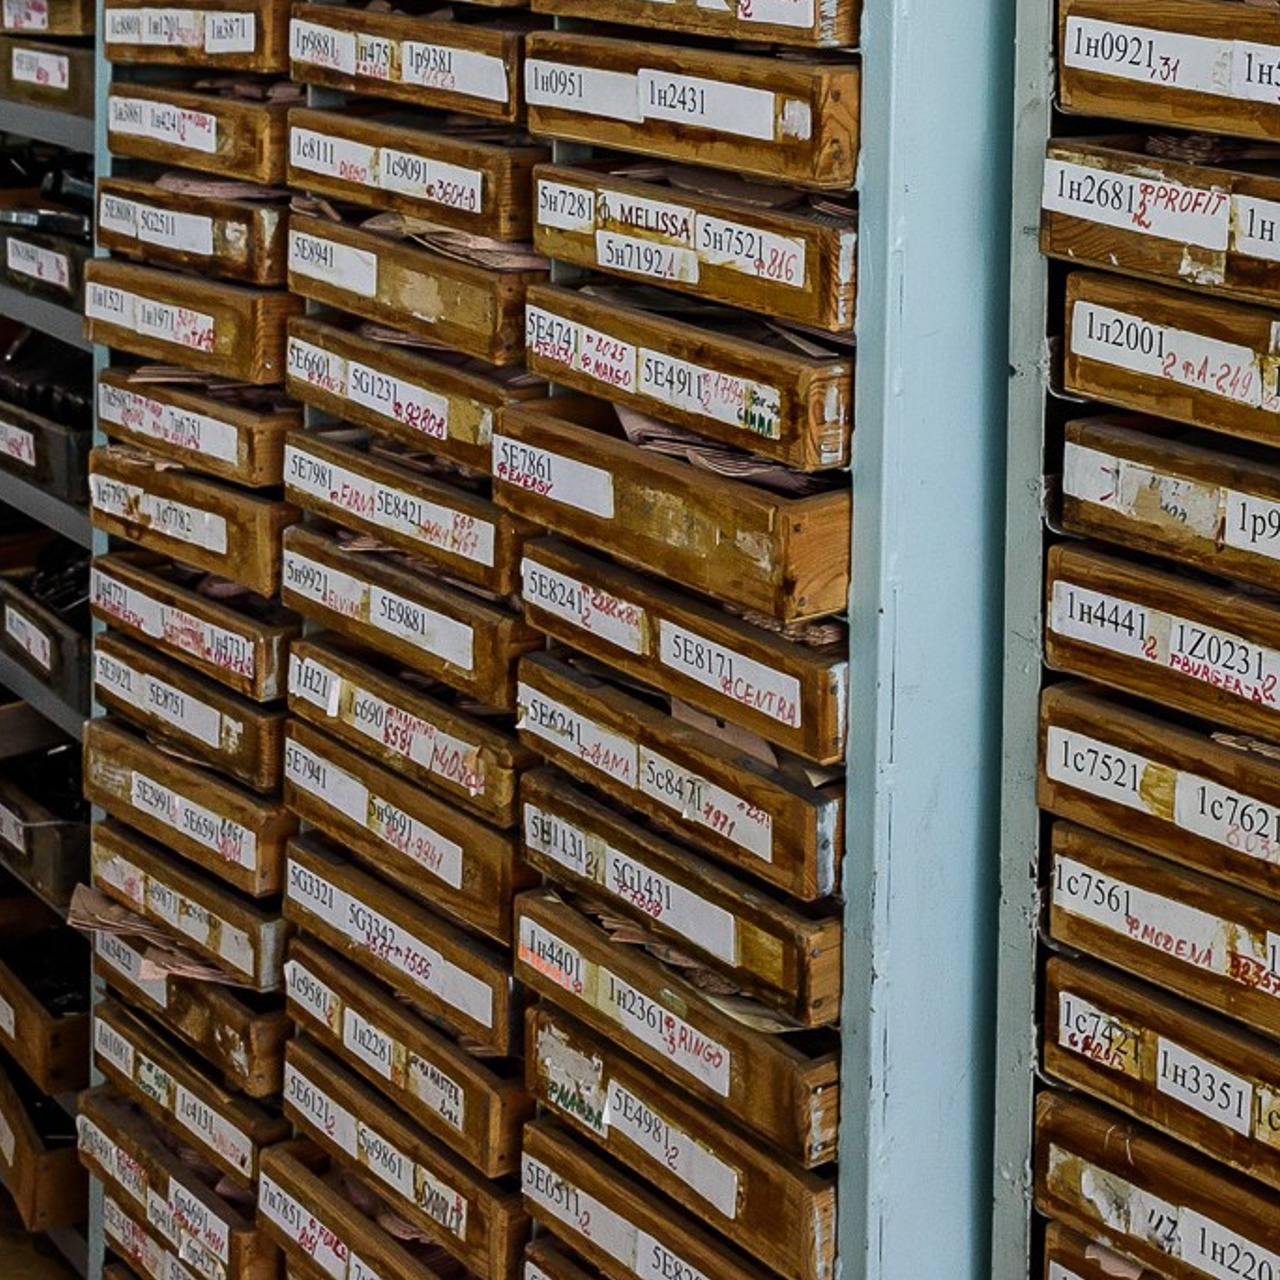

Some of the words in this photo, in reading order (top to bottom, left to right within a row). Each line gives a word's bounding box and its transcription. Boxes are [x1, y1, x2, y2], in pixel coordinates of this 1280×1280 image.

[621, 204, 690, 241] MELISSA
[499, 443, 551, 483] 5E7861
[530, 571, 583, 617] 5E8241
[673, 635, 732, 685] 5E8171
[1178, 625, 1263, 681] 1Z0231
[1062, 738, 1139, 793] 1c7521
[1057, 864, 1132, 921] 1c7561
[613, 1089, 668, 1149] 5E4981
